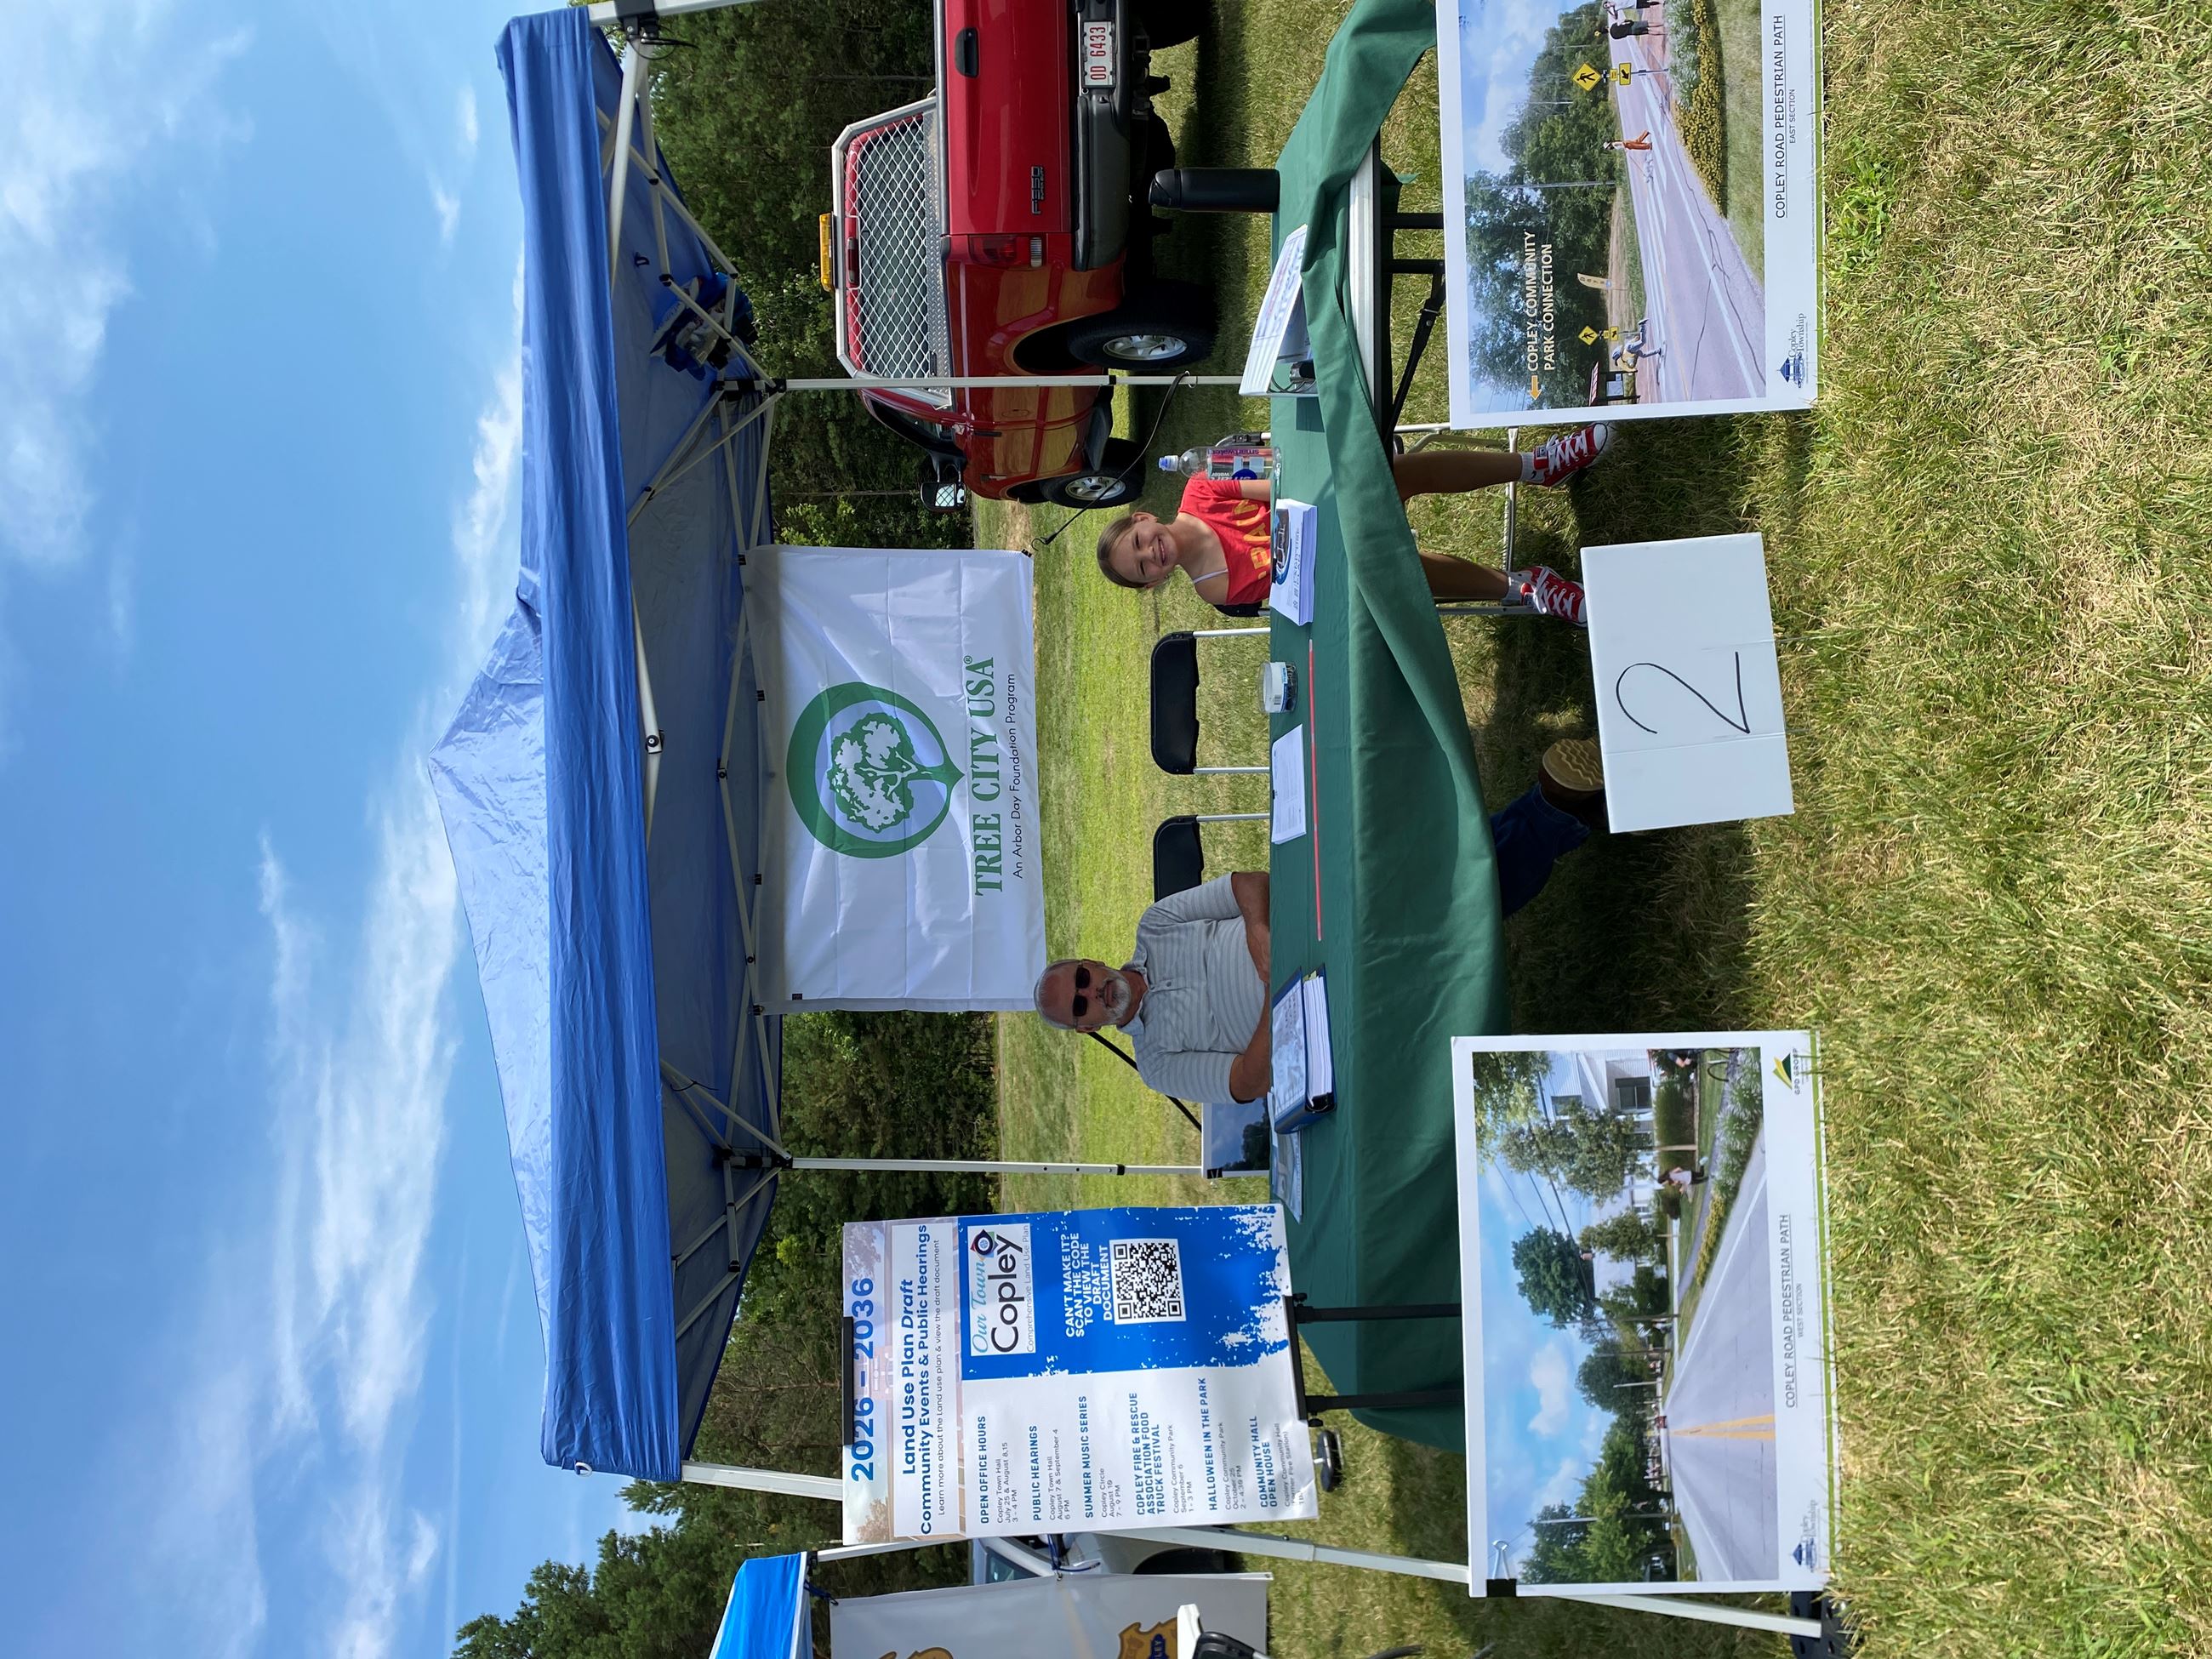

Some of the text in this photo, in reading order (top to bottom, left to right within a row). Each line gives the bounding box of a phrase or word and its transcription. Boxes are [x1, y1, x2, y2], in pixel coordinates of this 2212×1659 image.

[1089, 27, 1106, 80] OD 6433
[1774, 15, 1785, 218] COPLEY ROAD PEDESTRIAN PATH
[1525, 231, 1538, 371] COPLEY COMMUNITY
[1542, 244, 1555, 370] PARK CONNECTION
[1797, 313, 1806, 351] Township
[1788, 328, 1798, 357] Copley
[1234, 499, 1270, 580] PAIN
[1616, 652, 1750, 734] 2
[971, 727, 1001, 801] CITY
[1006, 674, 1023, 879] An Arbor Day Foundation Program
[972, 814, 1002, 896] TREE
[971, 1262, 988, 1352] Our Town
[988, 1234, 1023, 1352] Copley
[1061, 1234, 1074, 1337] CAN'T MAKE IT?
[1070, 1233, 1084, 1337] SCAN THE CODE
[1080, 1243, 1093, 1325] TO VIEW THE
[1092, 1263, 1101, 1304] DRAFT
[1099, 1246, 1112, 1320] DOCUMENT
[1779, 1215, 1795, 1408] COPLEY ROAD PEDESTRIAN PATH
[852, 1279, 873, 1360] 2036
[1024, 1286, 1035, 1353] Comprehensive
[900, 1280, 915, 1474] Land Use Plan Draft
[916, 1225, 933, 1534] Community Events & Public Hearings
[1198, 1377, 1208, 1405] PARK
[852, 1398, 874, 1482] 2026
[1129, 1393, 1139, 1434] RESCUE
[1203, 1433, 1211, 1442] IN
[978, 1416, 989, 1524] OPEN OFFICE HOURS
[1029, 1426, 1041, 1520] PUBLIC HEARINGS
[1053, 1437, 1062, 1476] September
[1079, 1396, 1093, 1518] SUMMER MUSIC SERIES
[1133, 1447, 1143, 1470] FIRE
[1140, 1412, 1154, 1514] ASSOCIATION FOOD
[1151, 1424, 1165, 1514] TRUCK FESTIVAL
[1168, 1443, 1177, 1485] Community
[1186, 1481, 1193, 1494] PM
[1203, 1445, 1217, 1510] HALLOWEEN
[1219, 1441, 1229, 1481] Community
[1229, 1468, 1236, 1478] 25
[1235, 1466, 1242, 1477] PM
[1250, 1416, 1268, 1508] COMMUNITY HALL
[1263, 1443, 1278, 1507] OPEN HOUSE
[1277, 1438, 1287, 1479] Community
[1004, 1496, 1010, 1505] 25
[1011, 1490, 1018, 1502] PM
[1063, 1500, 1069, 1512] PM
[1115, 1485, 1121, 1497] PM
[1135, 1474, 1145, 1515] COPLEY
[1172, 1487, 1181, 1513] Copley
[1178, 1472, 1188, 1513] September
[1224, 1484, 1233, 1510] Copley
